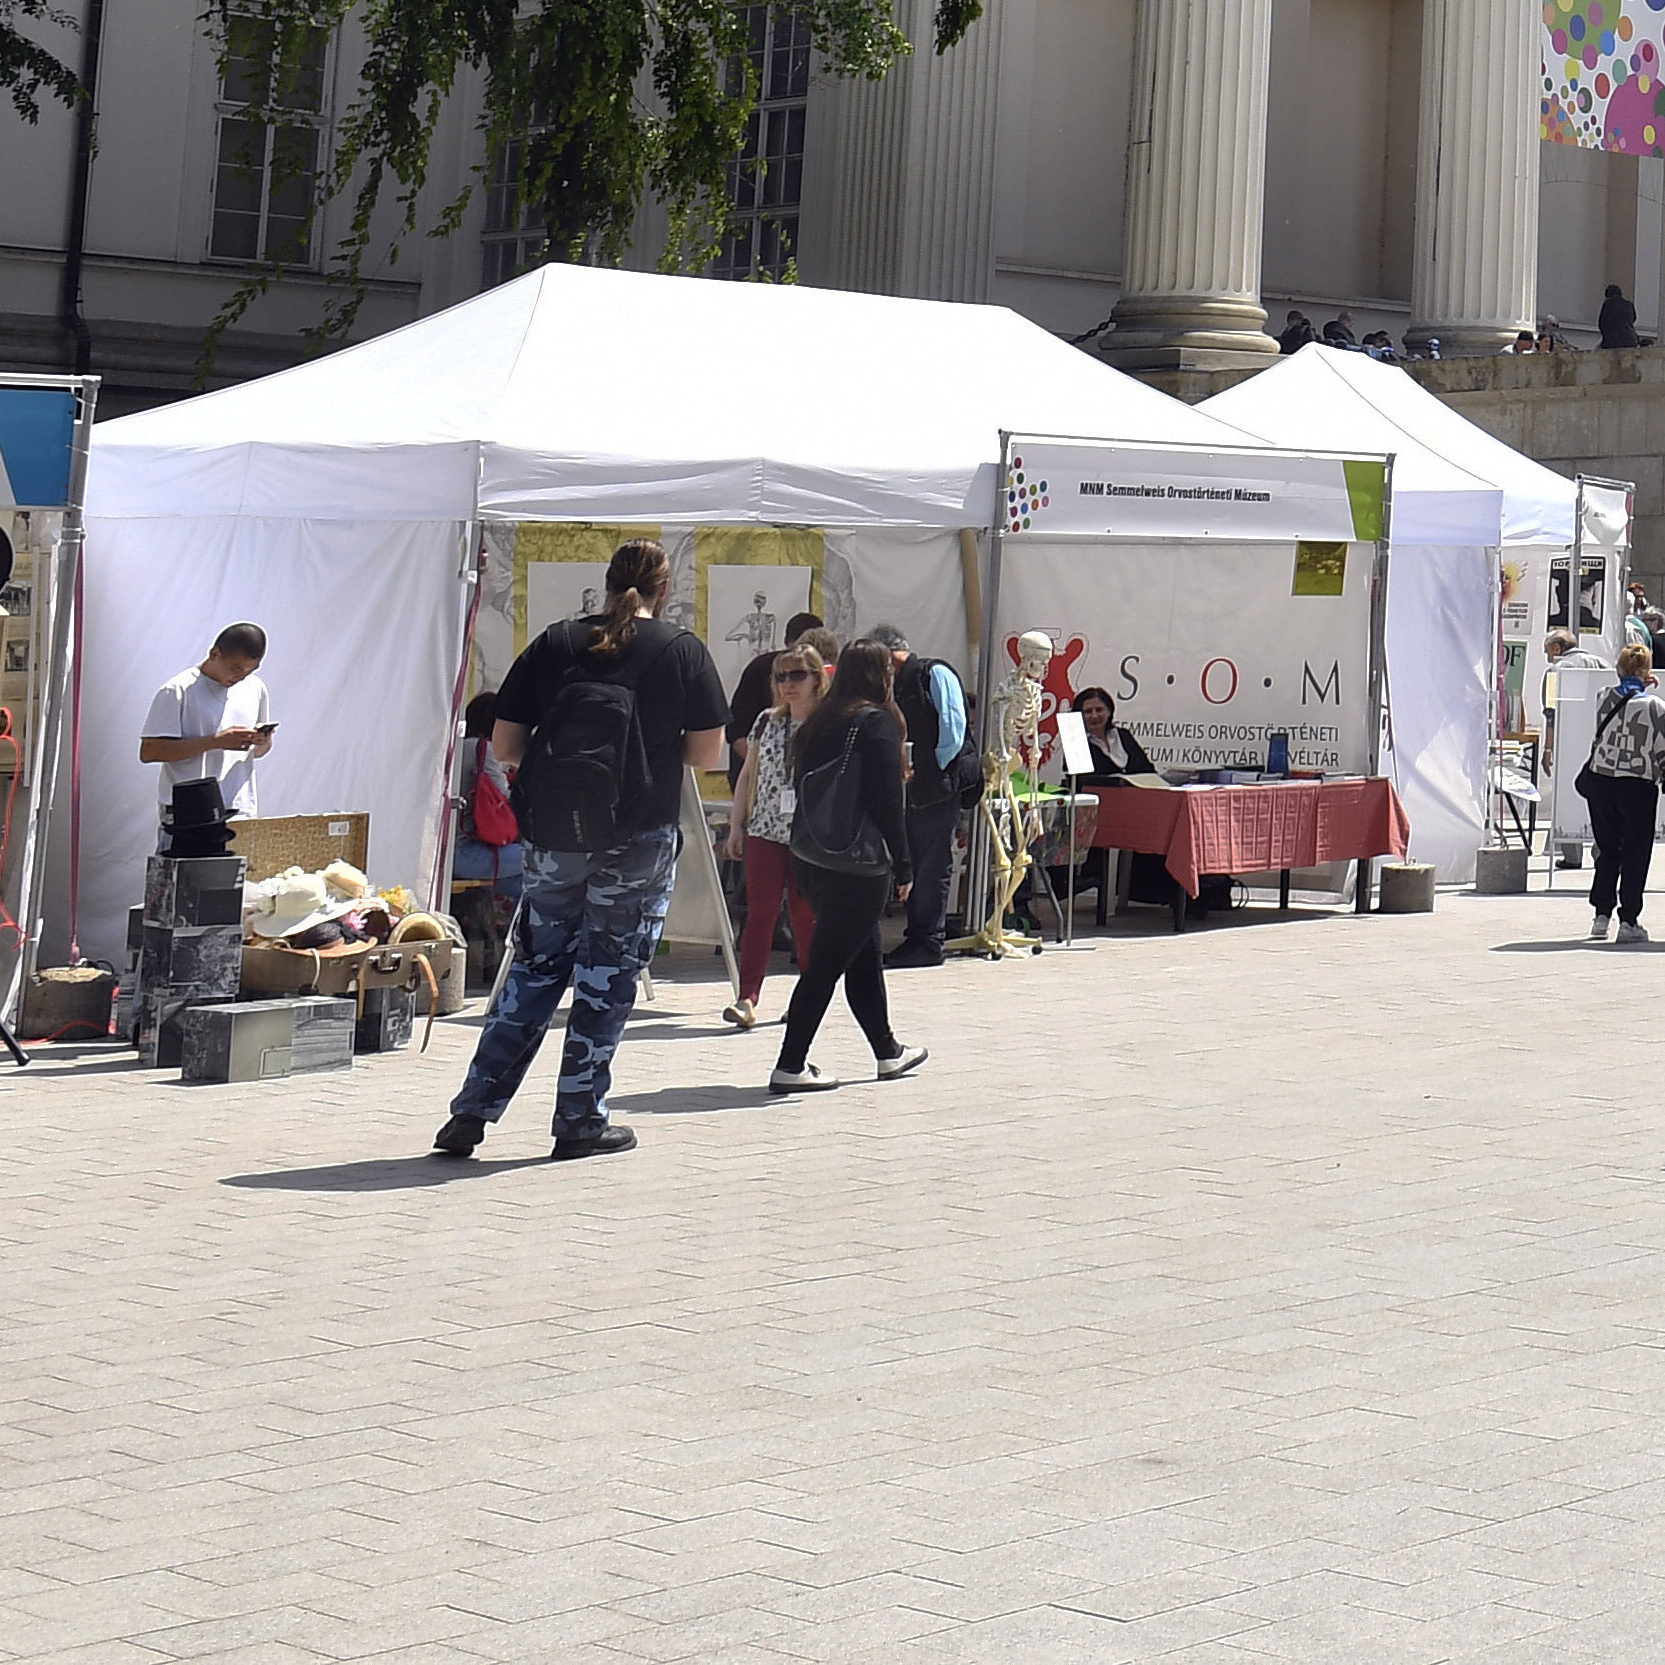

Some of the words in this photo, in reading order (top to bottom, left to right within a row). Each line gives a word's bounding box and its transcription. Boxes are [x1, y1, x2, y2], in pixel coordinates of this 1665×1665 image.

[1079, 482, 1104, 495] MNM
[1106, 483, 1165, 498] Semmelweis
[1167, 485, 1232, 501] Orvostörténeti
[1234, 487, 1270, 502] Múzeum
[1113, 721, 1204, 739] MMELWEIS
[1182, 746, 1258, 765] KÖNYVTÁR
[1287, 747, 1339, 767] VÉLTÁR
